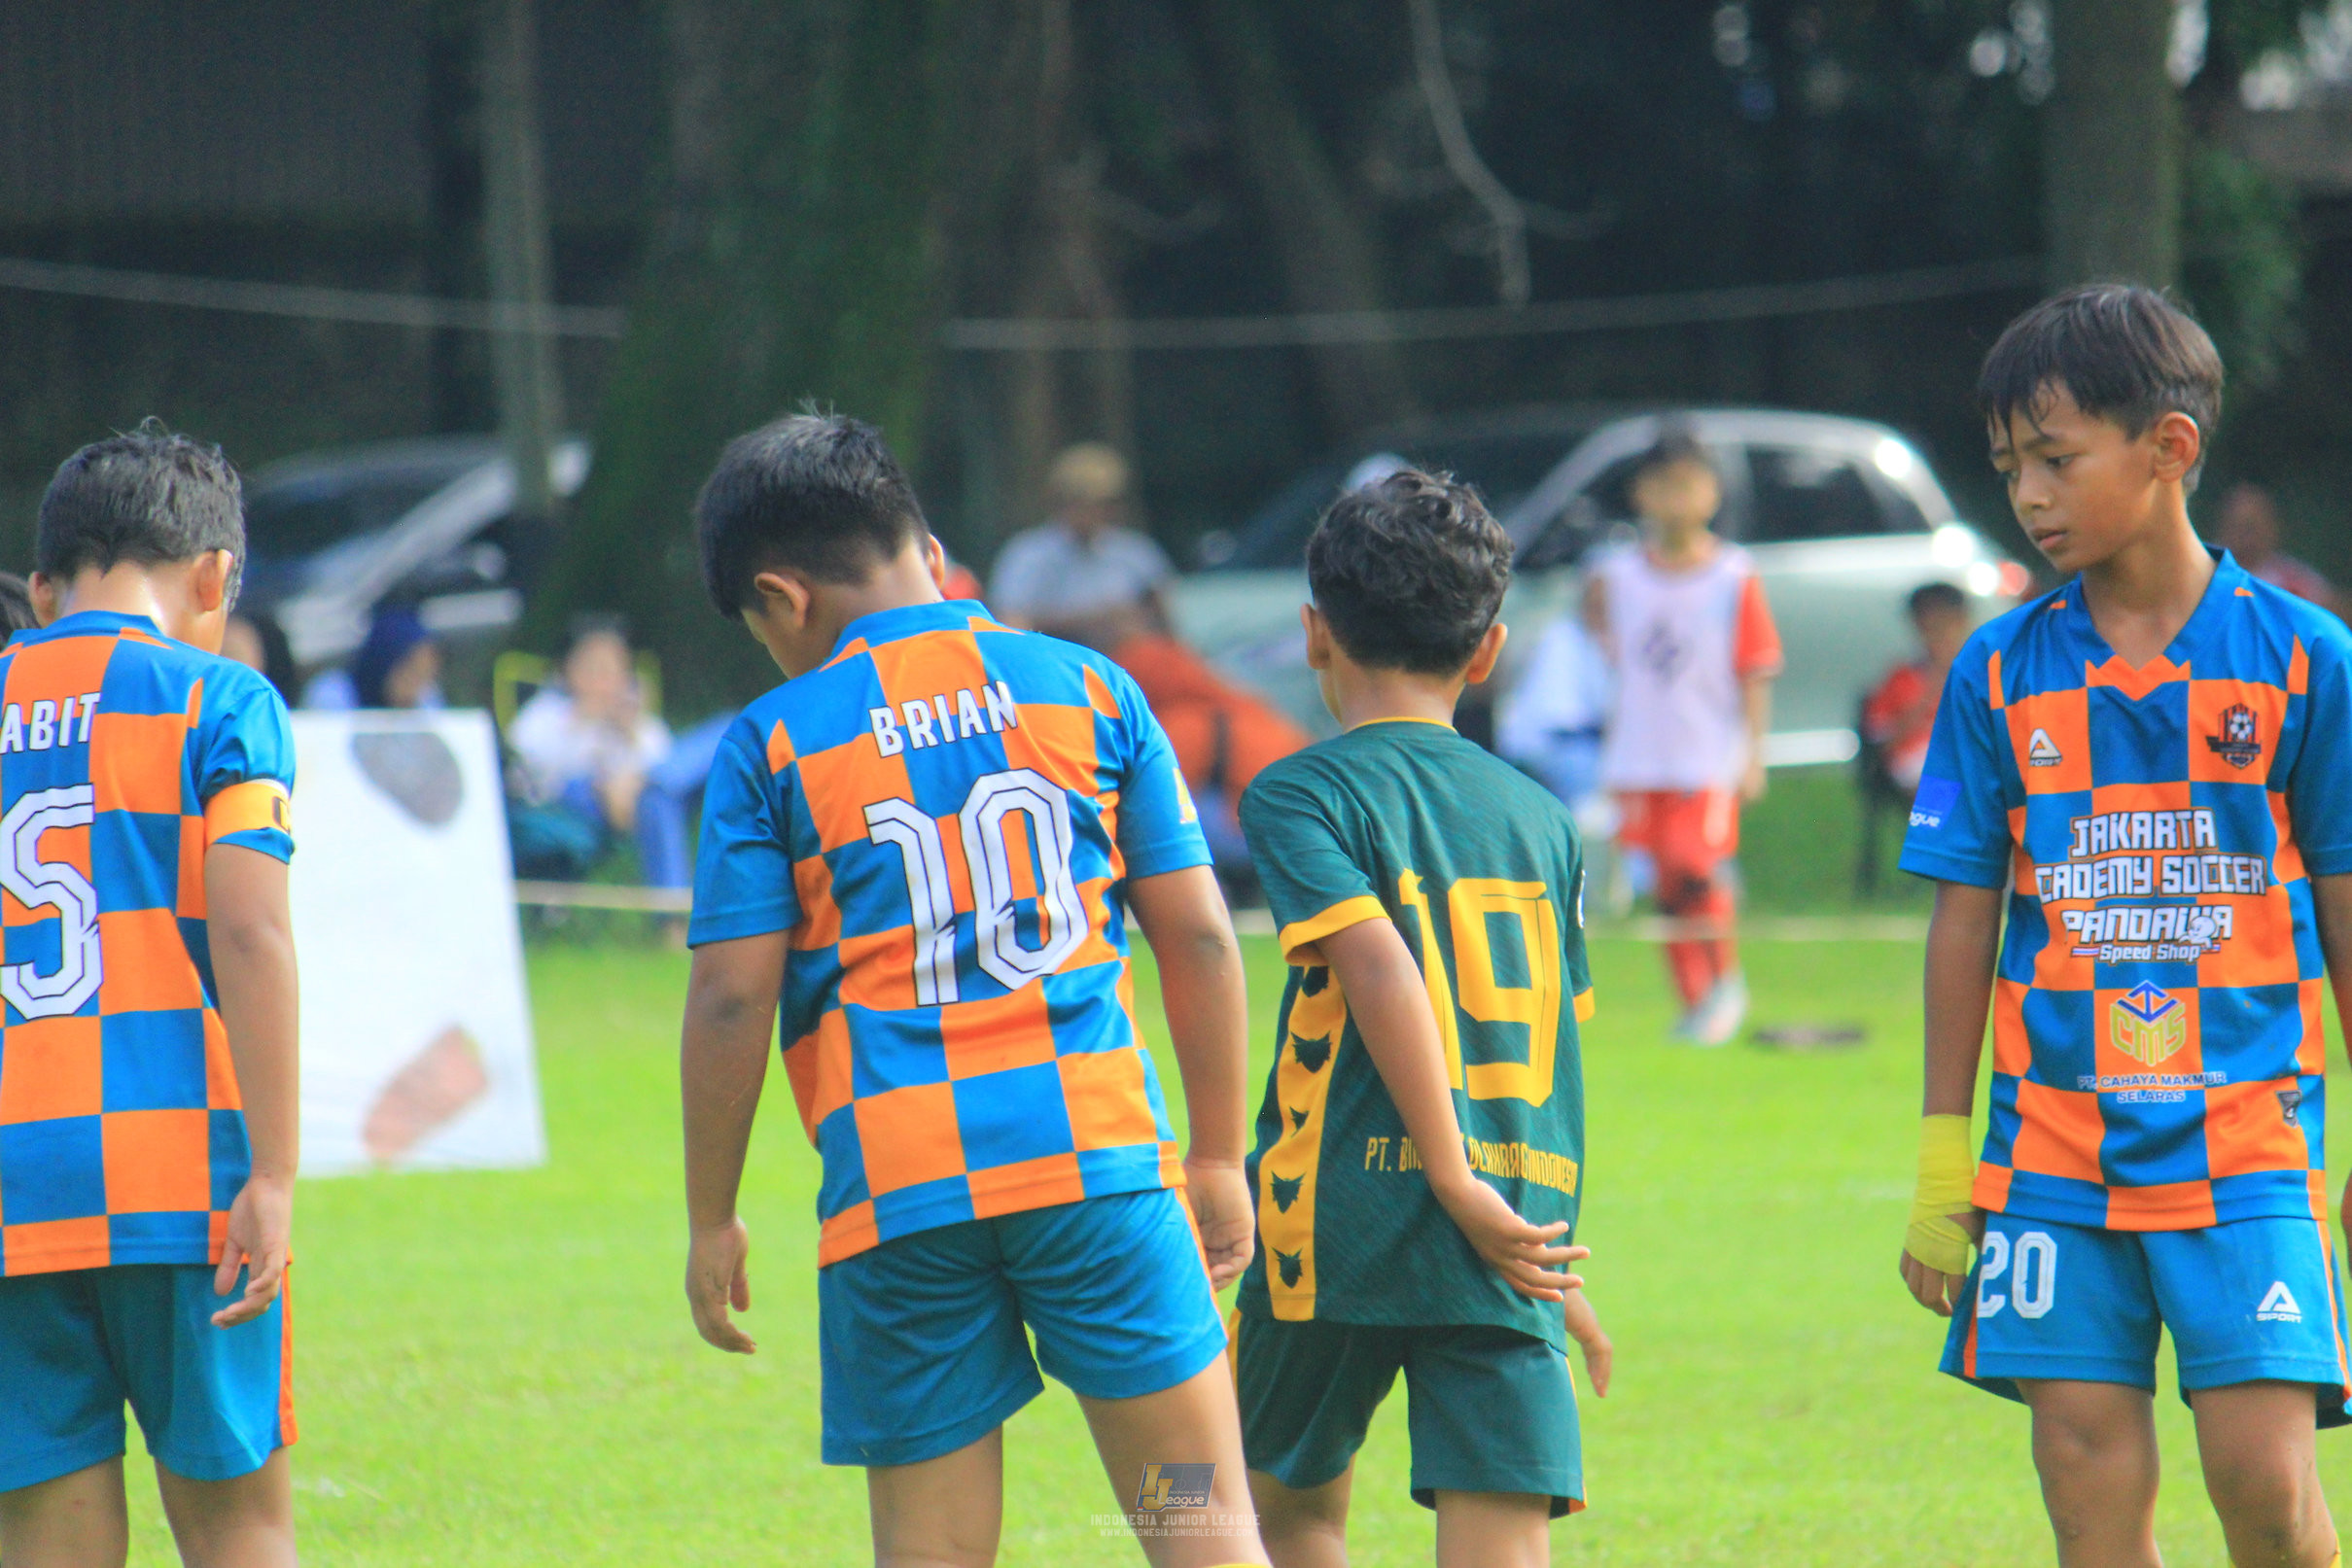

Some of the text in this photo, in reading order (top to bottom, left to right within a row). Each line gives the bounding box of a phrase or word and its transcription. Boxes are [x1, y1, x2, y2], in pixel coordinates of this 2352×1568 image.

[0, 691, 101, 755] ABIT
[868, 679, 1018, 758] BRIAN
[2070, 809, 2219, 857] JAKARTA
[0, 783, 104, 1022] 5
[862, 766, 1090, 1007] 10
[2160, 854, 2267, 895] SOCCER
[2098, 943, 2201, 965] Speed Shop
[1397, 867, 1561, 1108] 19
[2110, 1002, 2187, 1067] CMS
[2099, 1072, 2159, 1089] CAHAYA
[2159, 1070, 2228, 1088] MAKMUR
[2117, 1089, 2187, 1104] SELARAS
[1364, 1136, 1392, 1171] PT.
[1977, 1231, 2058, 1320] 20
